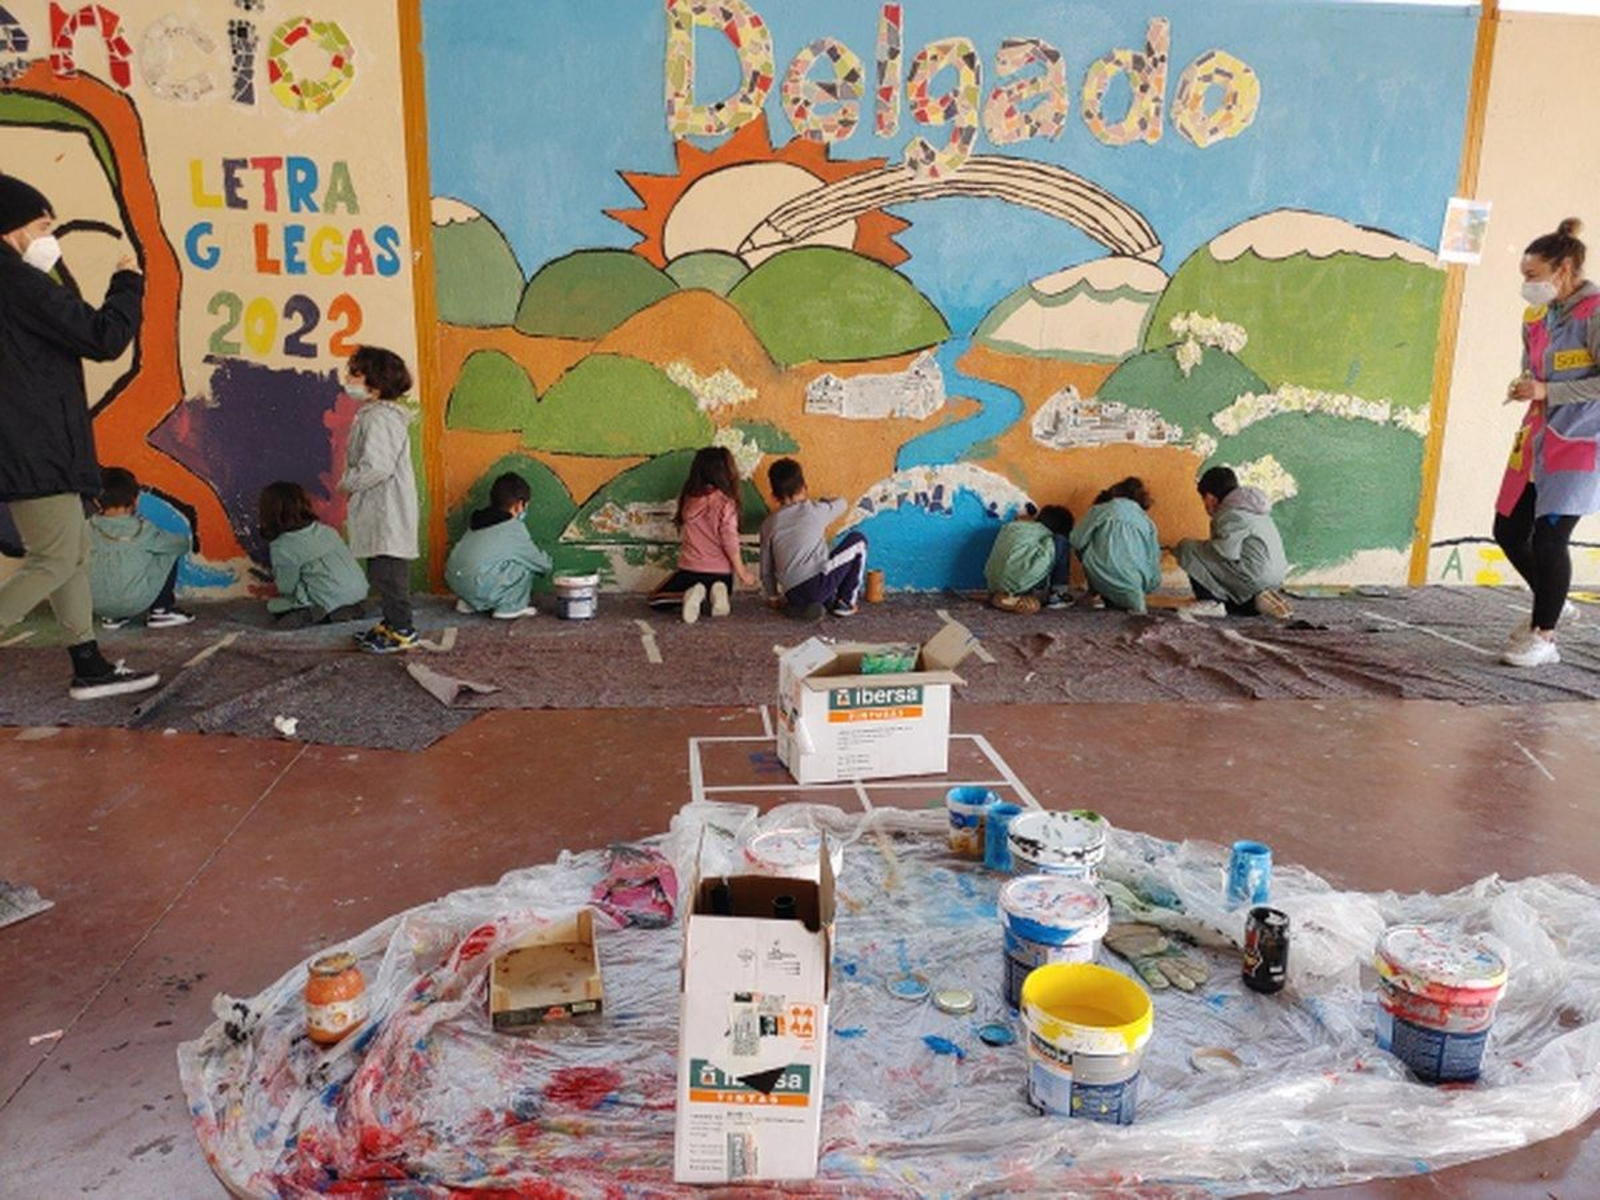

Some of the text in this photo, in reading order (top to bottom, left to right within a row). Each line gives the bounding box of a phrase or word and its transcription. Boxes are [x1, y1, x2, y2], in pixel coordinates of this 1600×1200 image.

[664, 0, 1261, 182] Delgado
[187, 155, 361, 215] LETRA
[207, 290, 362, 359] 2022
[855, 685, 918, 706] ibersa
